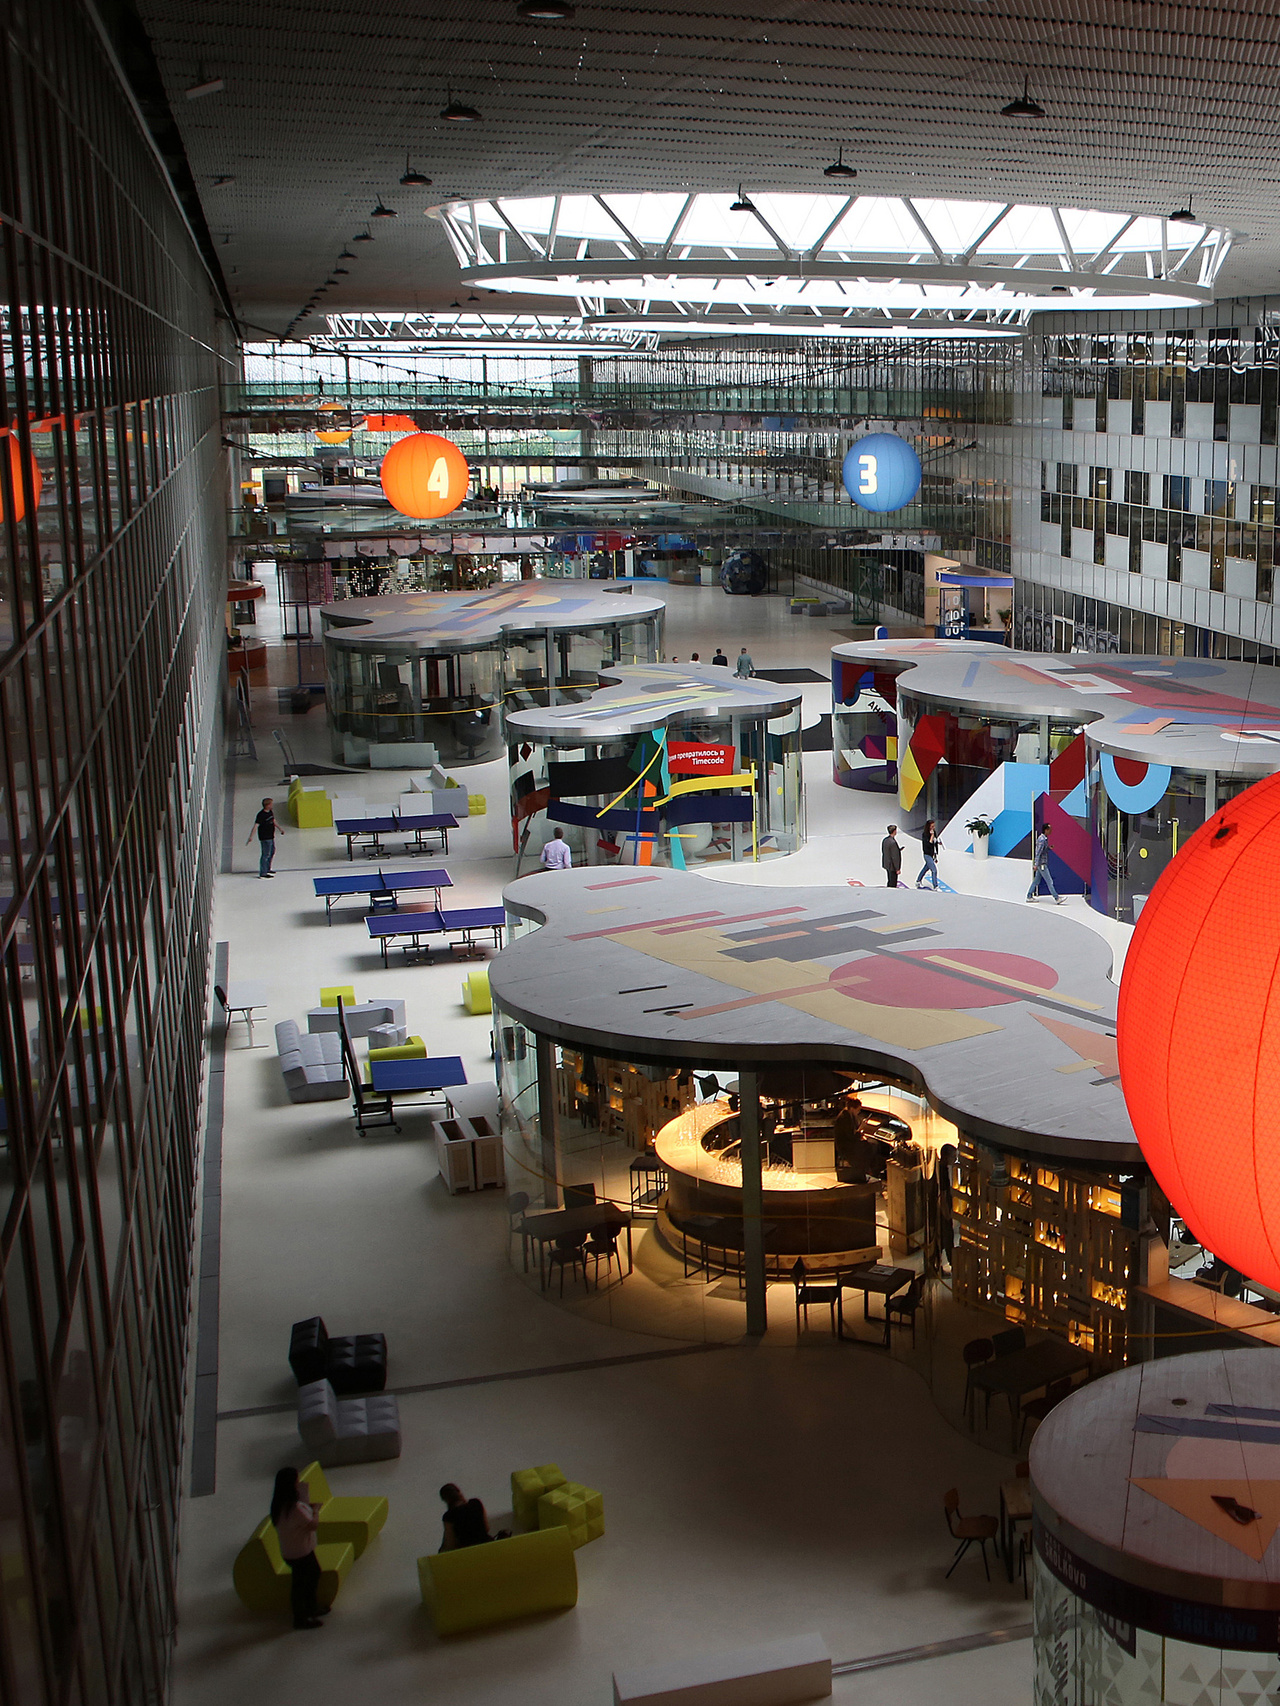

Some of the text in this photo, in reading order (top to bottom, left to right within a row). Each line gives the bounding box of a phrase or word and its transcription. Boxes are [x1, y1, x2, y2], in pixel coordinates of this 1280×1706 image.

[427, 456, 449, 499] 4
[858, 454, 878, 495] 3
[692, 757, 725, 765] Timecode
